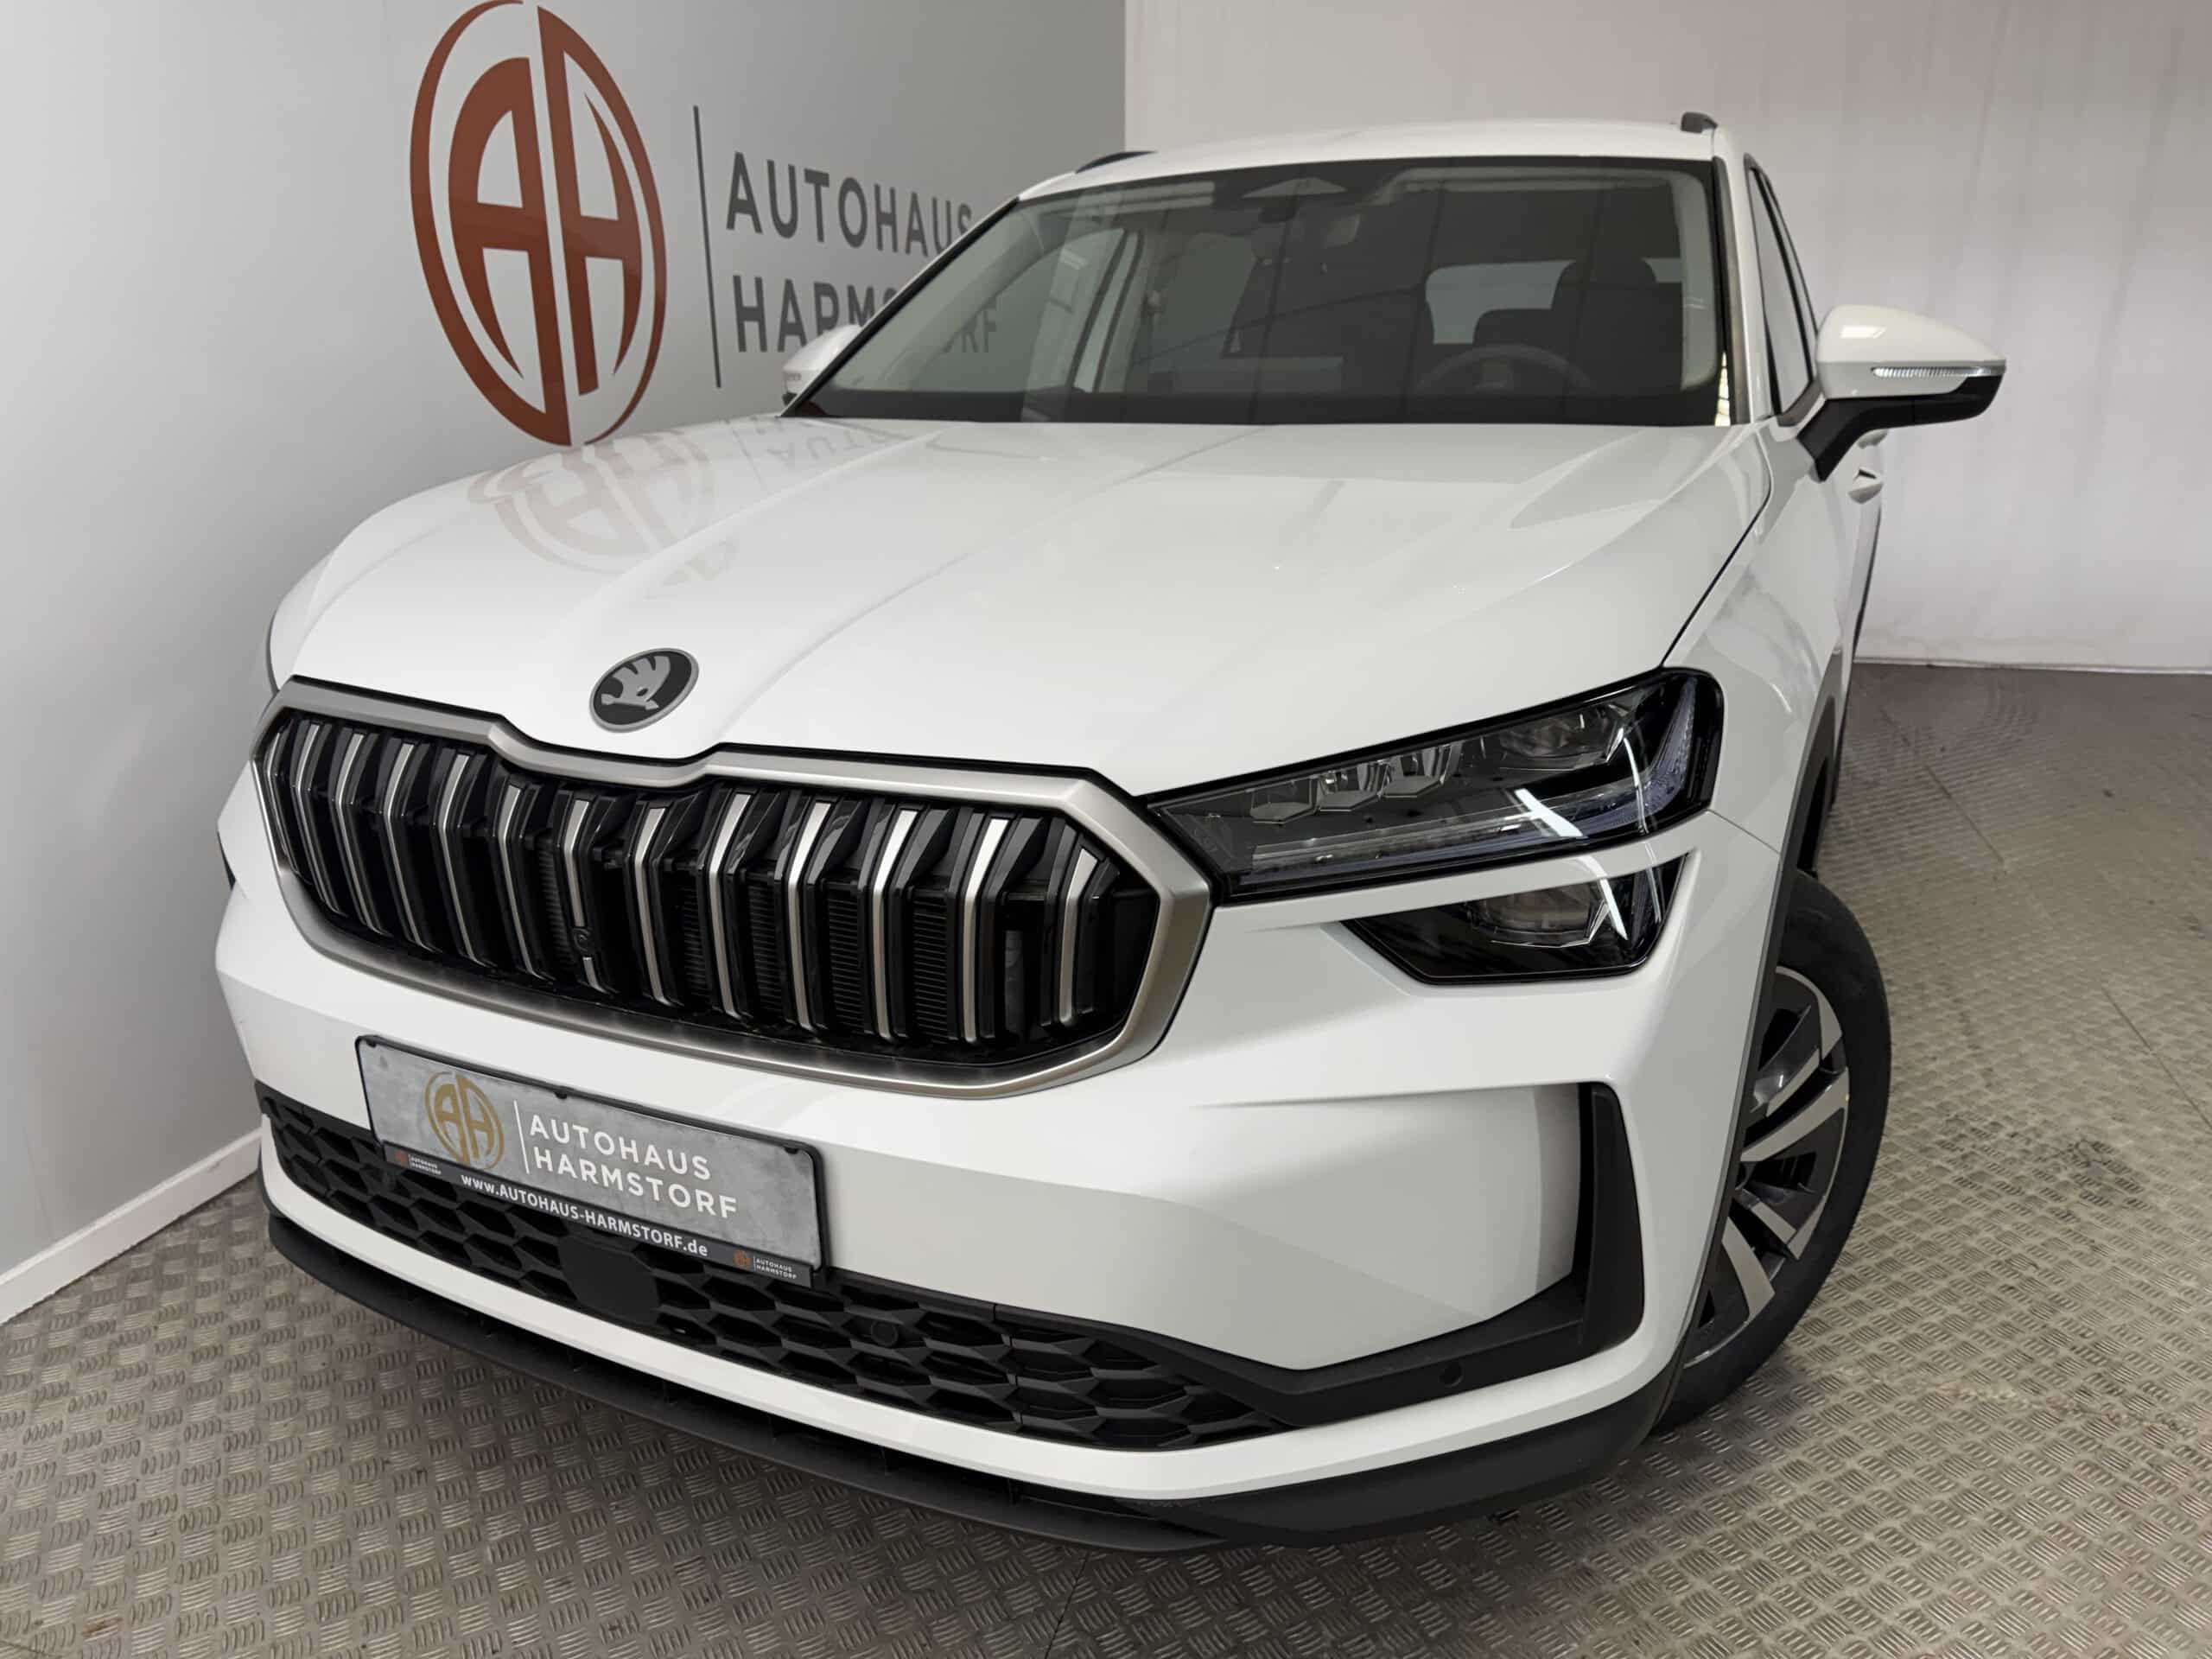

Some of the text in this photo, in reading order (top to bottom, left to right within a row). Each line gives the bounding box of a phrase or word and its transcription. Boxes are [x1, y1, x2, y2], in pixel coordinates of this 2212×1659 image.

[529, 1114, 711, 1180] AUTOHAUS
[534, 1147, 739, 1220] HARMSTORF
[461, 1174, 709, 1257] www.AUTOHAUS-HARMSTORF.de
